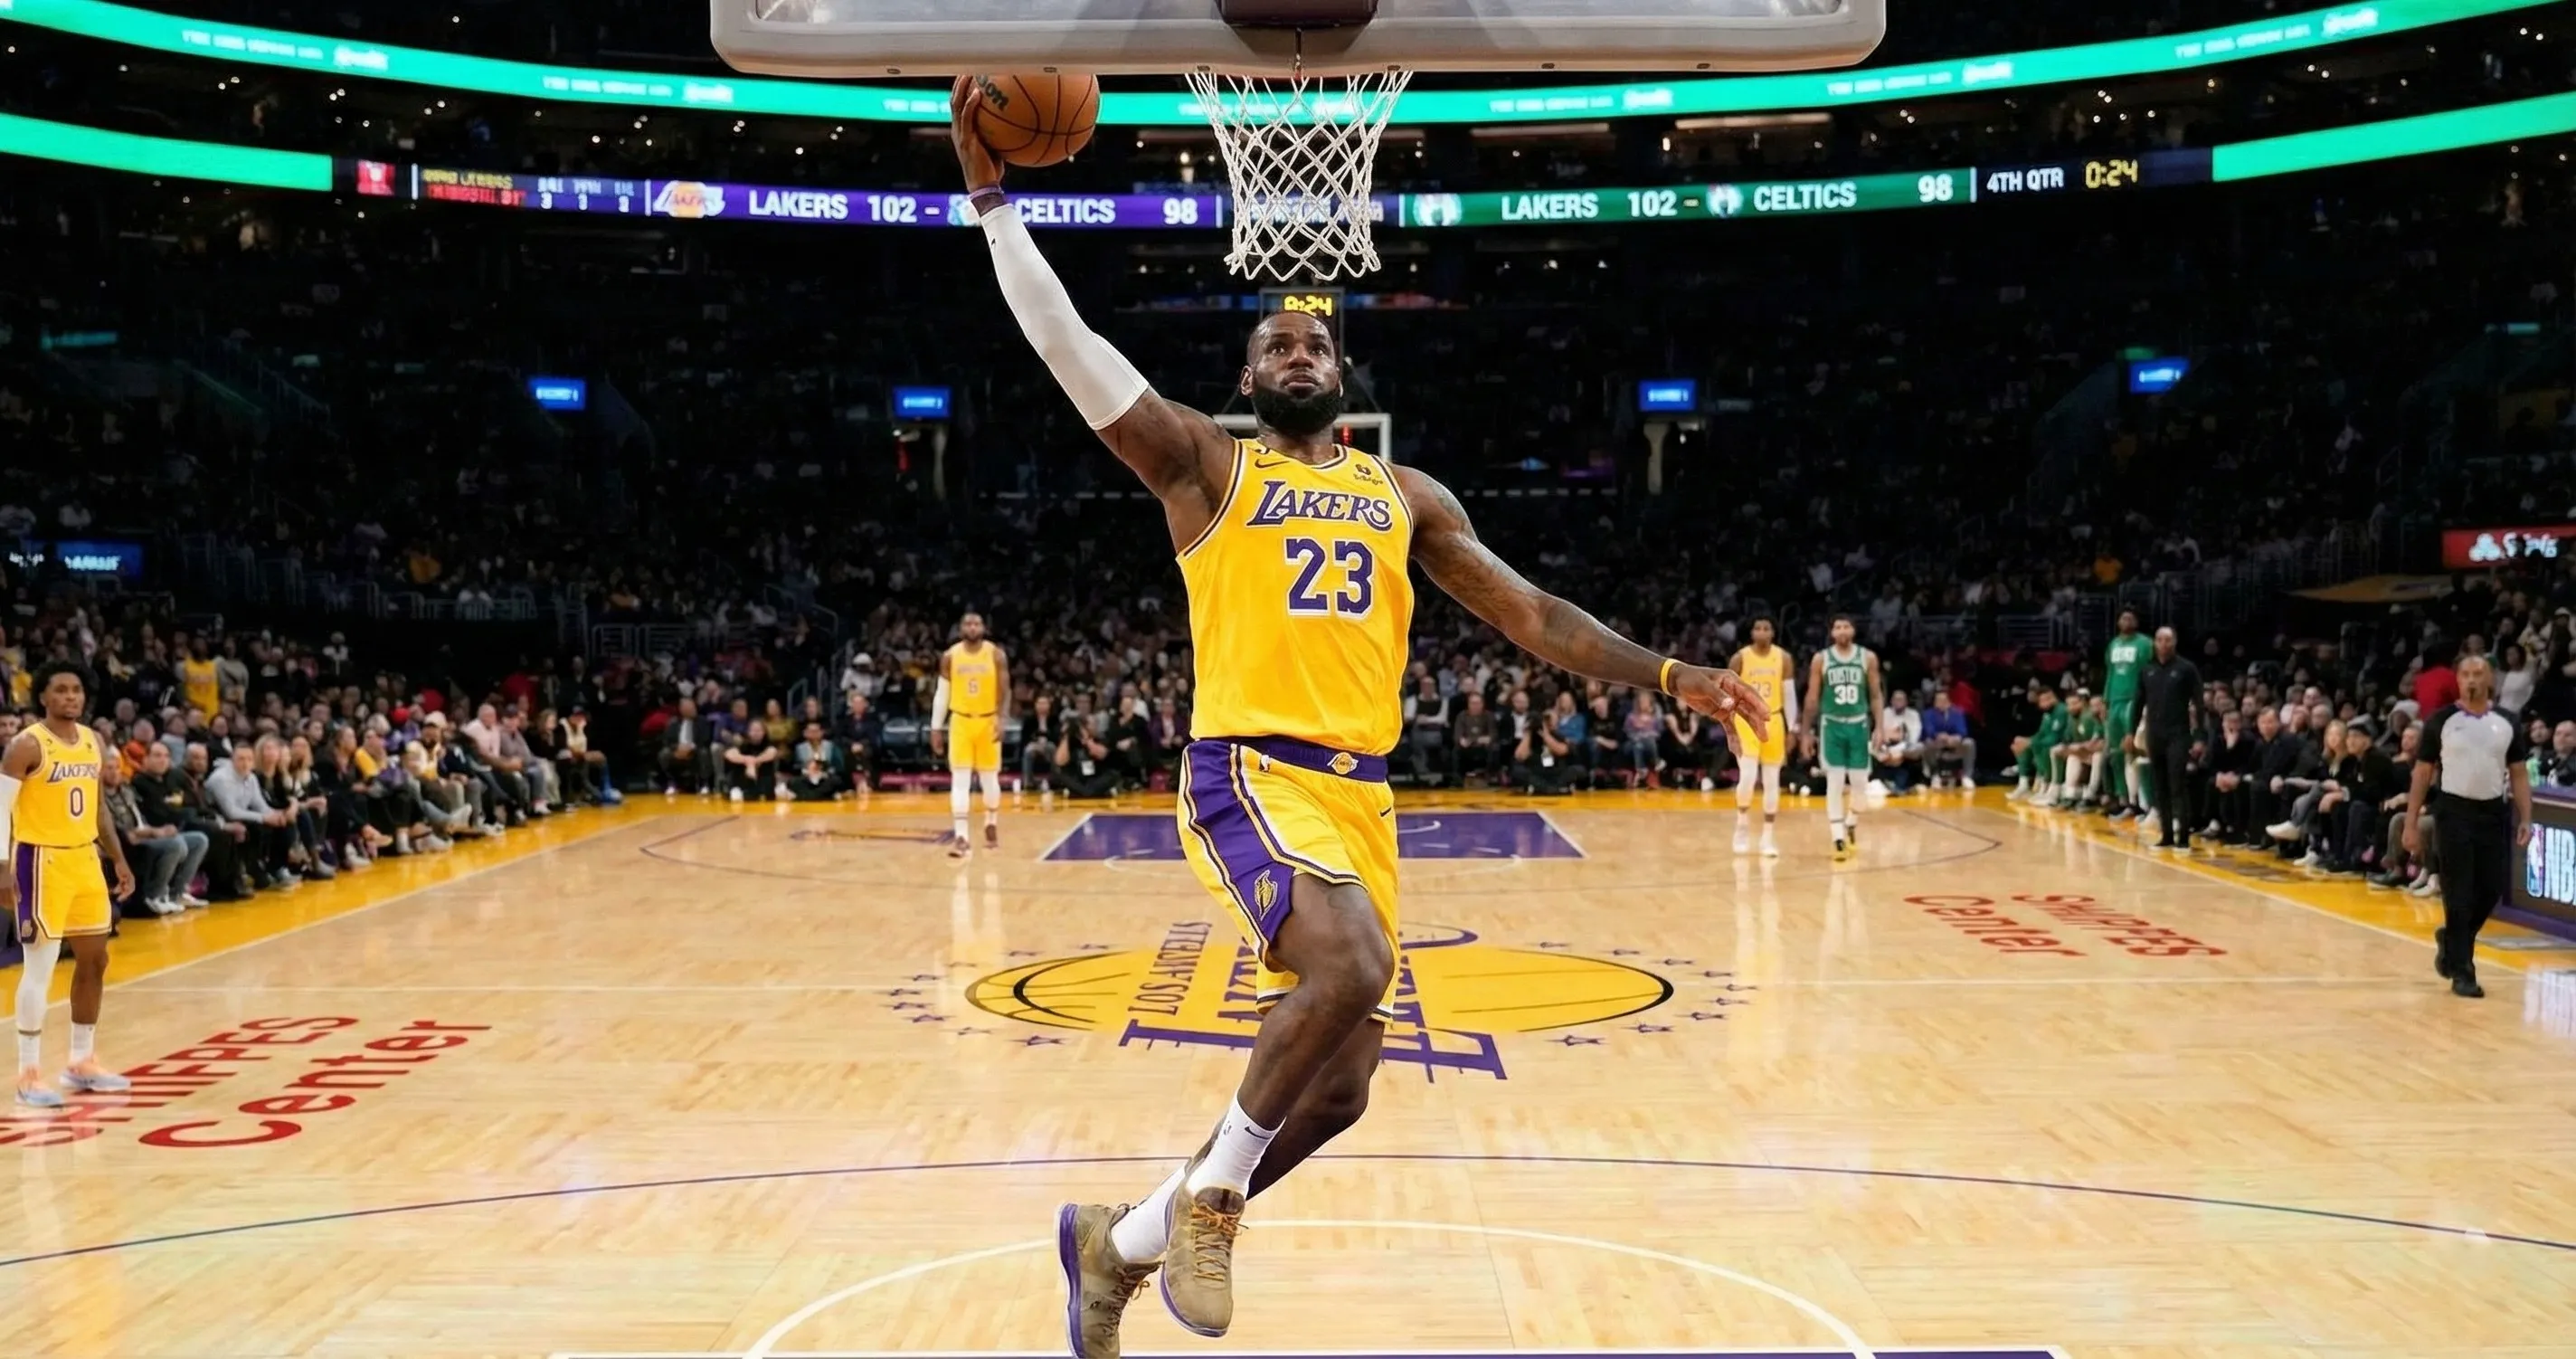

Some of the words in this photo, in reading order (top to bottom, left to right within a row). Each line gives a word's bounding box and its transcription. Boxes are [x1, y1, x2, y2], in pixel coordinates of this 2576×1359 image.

[1501, 191, 1599, 221] LAKERS
[1627, 189, 1677, 218] 102
[1753, 181, 1857, 213] CELTICS
[1918, 174, 1954, 203] 98
[1987, 170, 2023, 194] 4TH
[2027, 167, 2064, 191] QTR
[2085, 159, 2139, 188] 0:24
[749, 189, 849, 220] LAKERS
[867, 195, 917, 223] 102
[1015, 197, 1116, 224] CELTICS
[1162, 198, 1198, 225] 98
[1245, 480, 1393, 532] LAKERS
[1284, 536, 1377, 621] 23
[1834, 685, 1860, 706] 30
[69, 785, 84, 818] 0
[2543, 826, 2576, 906] NB
[1904, 895, 2088, 957] Center
[1127, 978, 1190, 1016] LOS
[138, 1020, 492, 1148] Center
